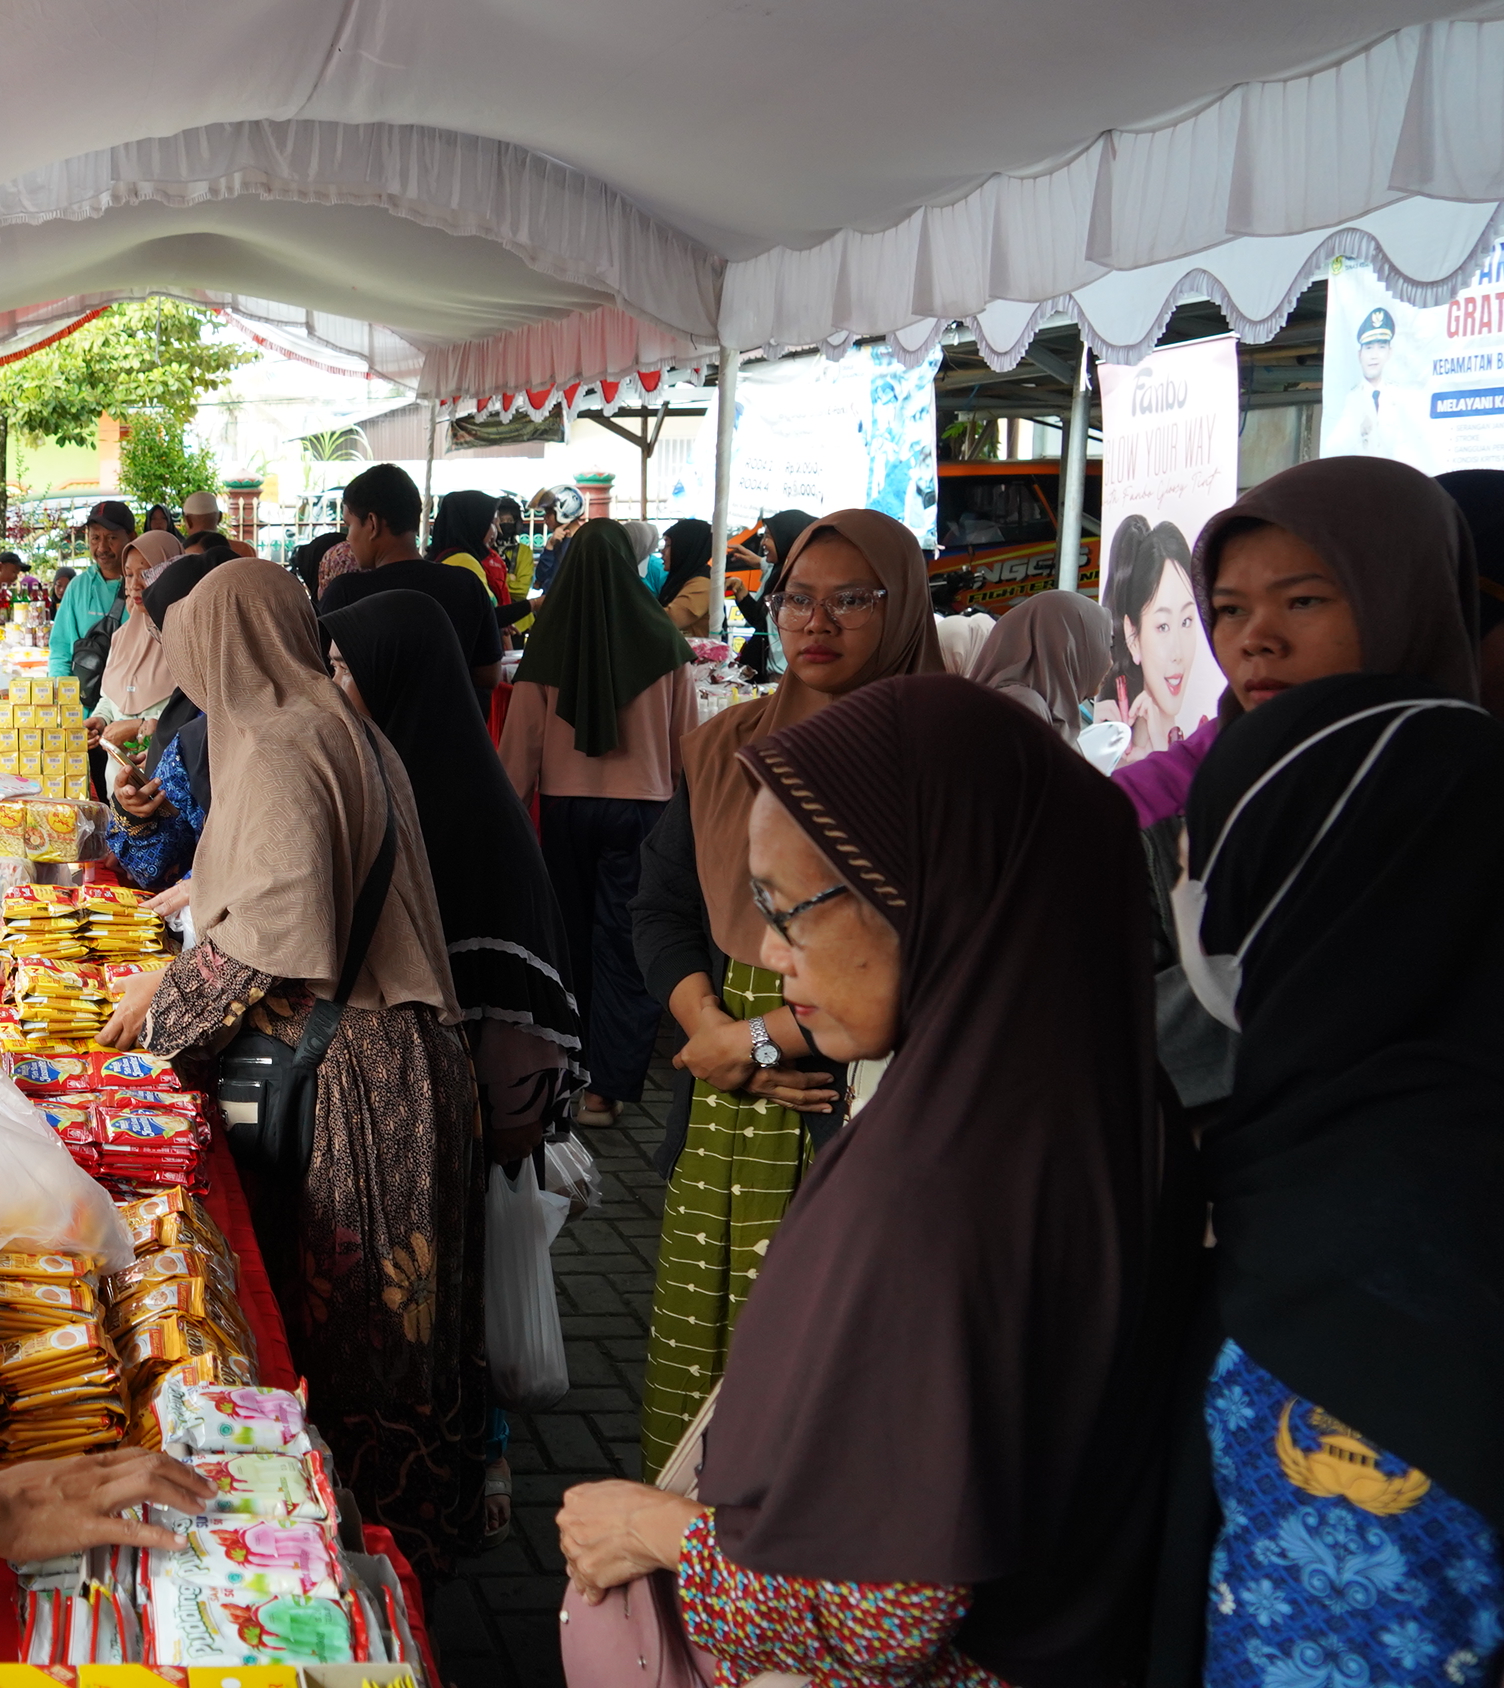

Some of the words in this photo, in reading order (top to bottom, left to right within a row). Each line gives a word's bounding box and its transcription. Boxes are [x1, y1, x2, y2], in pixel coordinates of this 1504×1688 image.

[1432, 353, 1493, 377] KECAMATAN
[1436, 395, 1493, 413] MELAYANI
[1145, 422, 1178, 477] YOUR
[1184, 413, 1216, 469] WAY
[968, 580, 1055, 603] FIGHTER
[173, 1585, 223, 1659] Pudding
